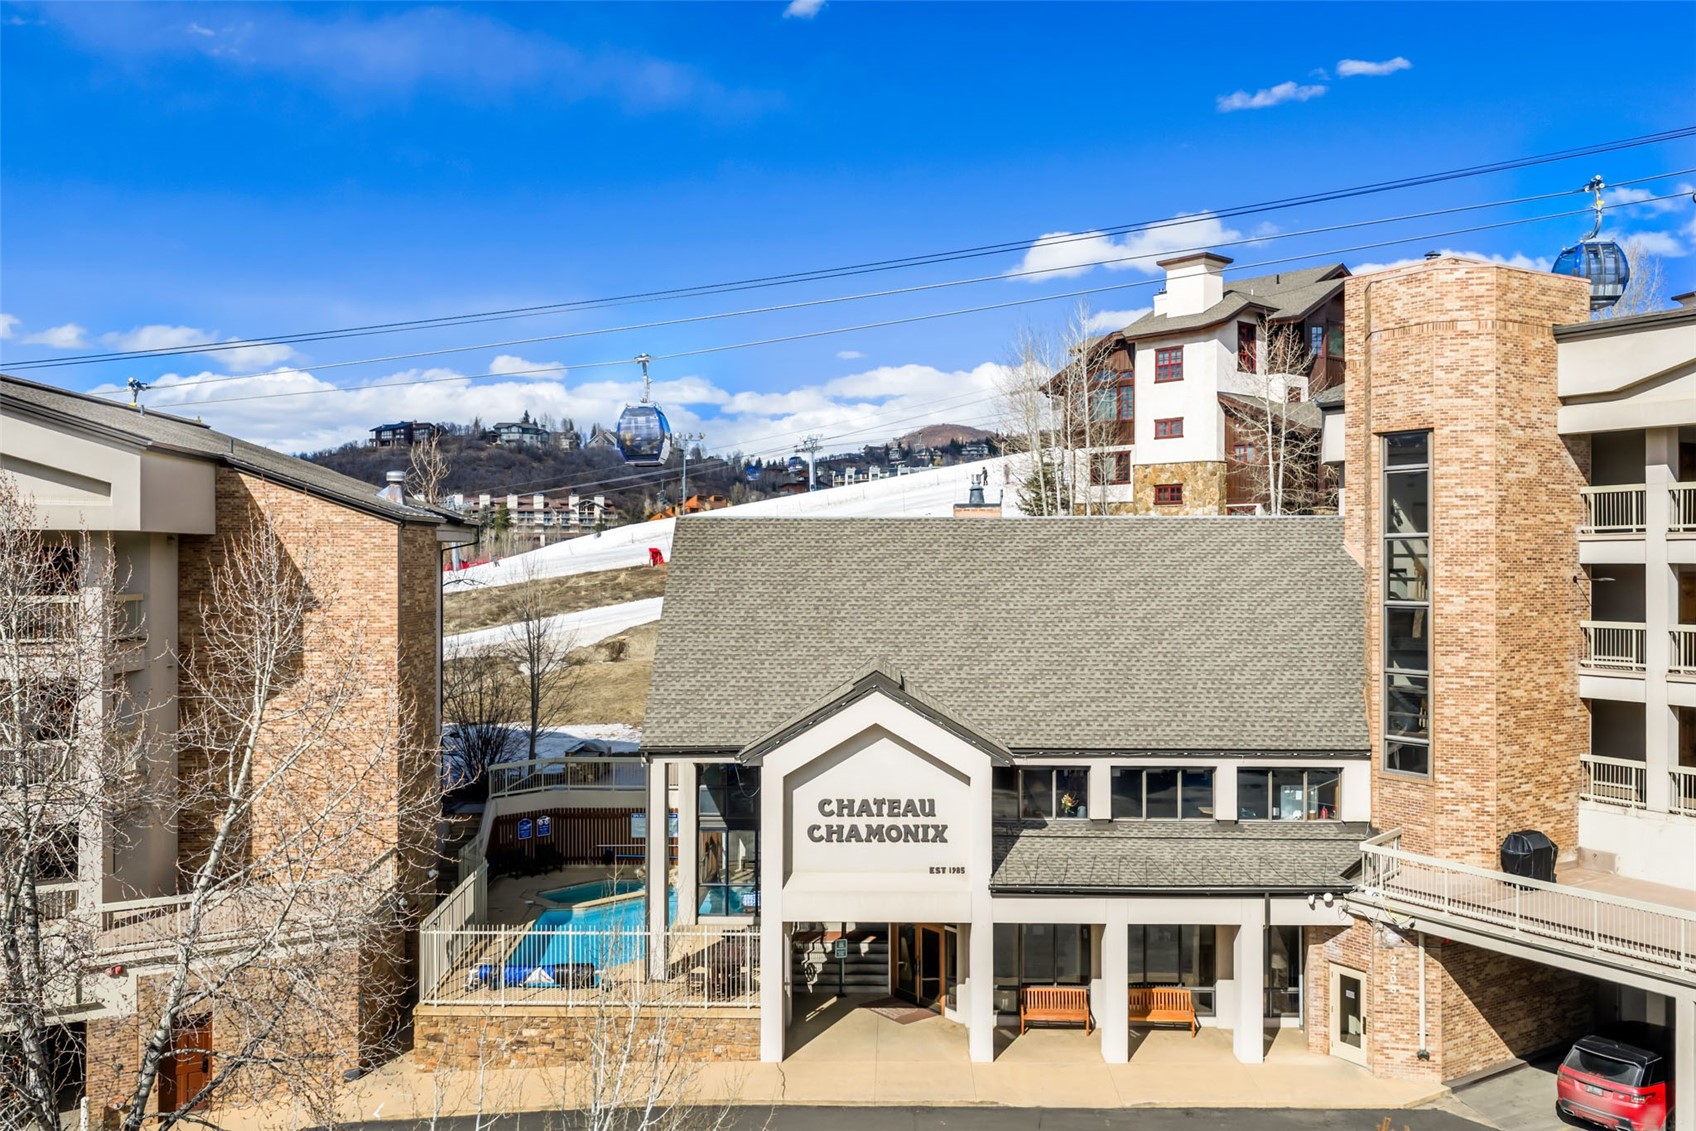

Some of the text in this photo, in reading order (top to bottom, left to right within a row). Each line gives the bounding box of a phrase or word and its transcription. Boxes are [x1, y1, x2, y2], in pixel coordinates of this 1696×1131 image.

[818, 798, 936, 817] CHATEAU
[807, 824, 948, 843] CHAMONIX
[929, 866, 965, 874] EST 1985
